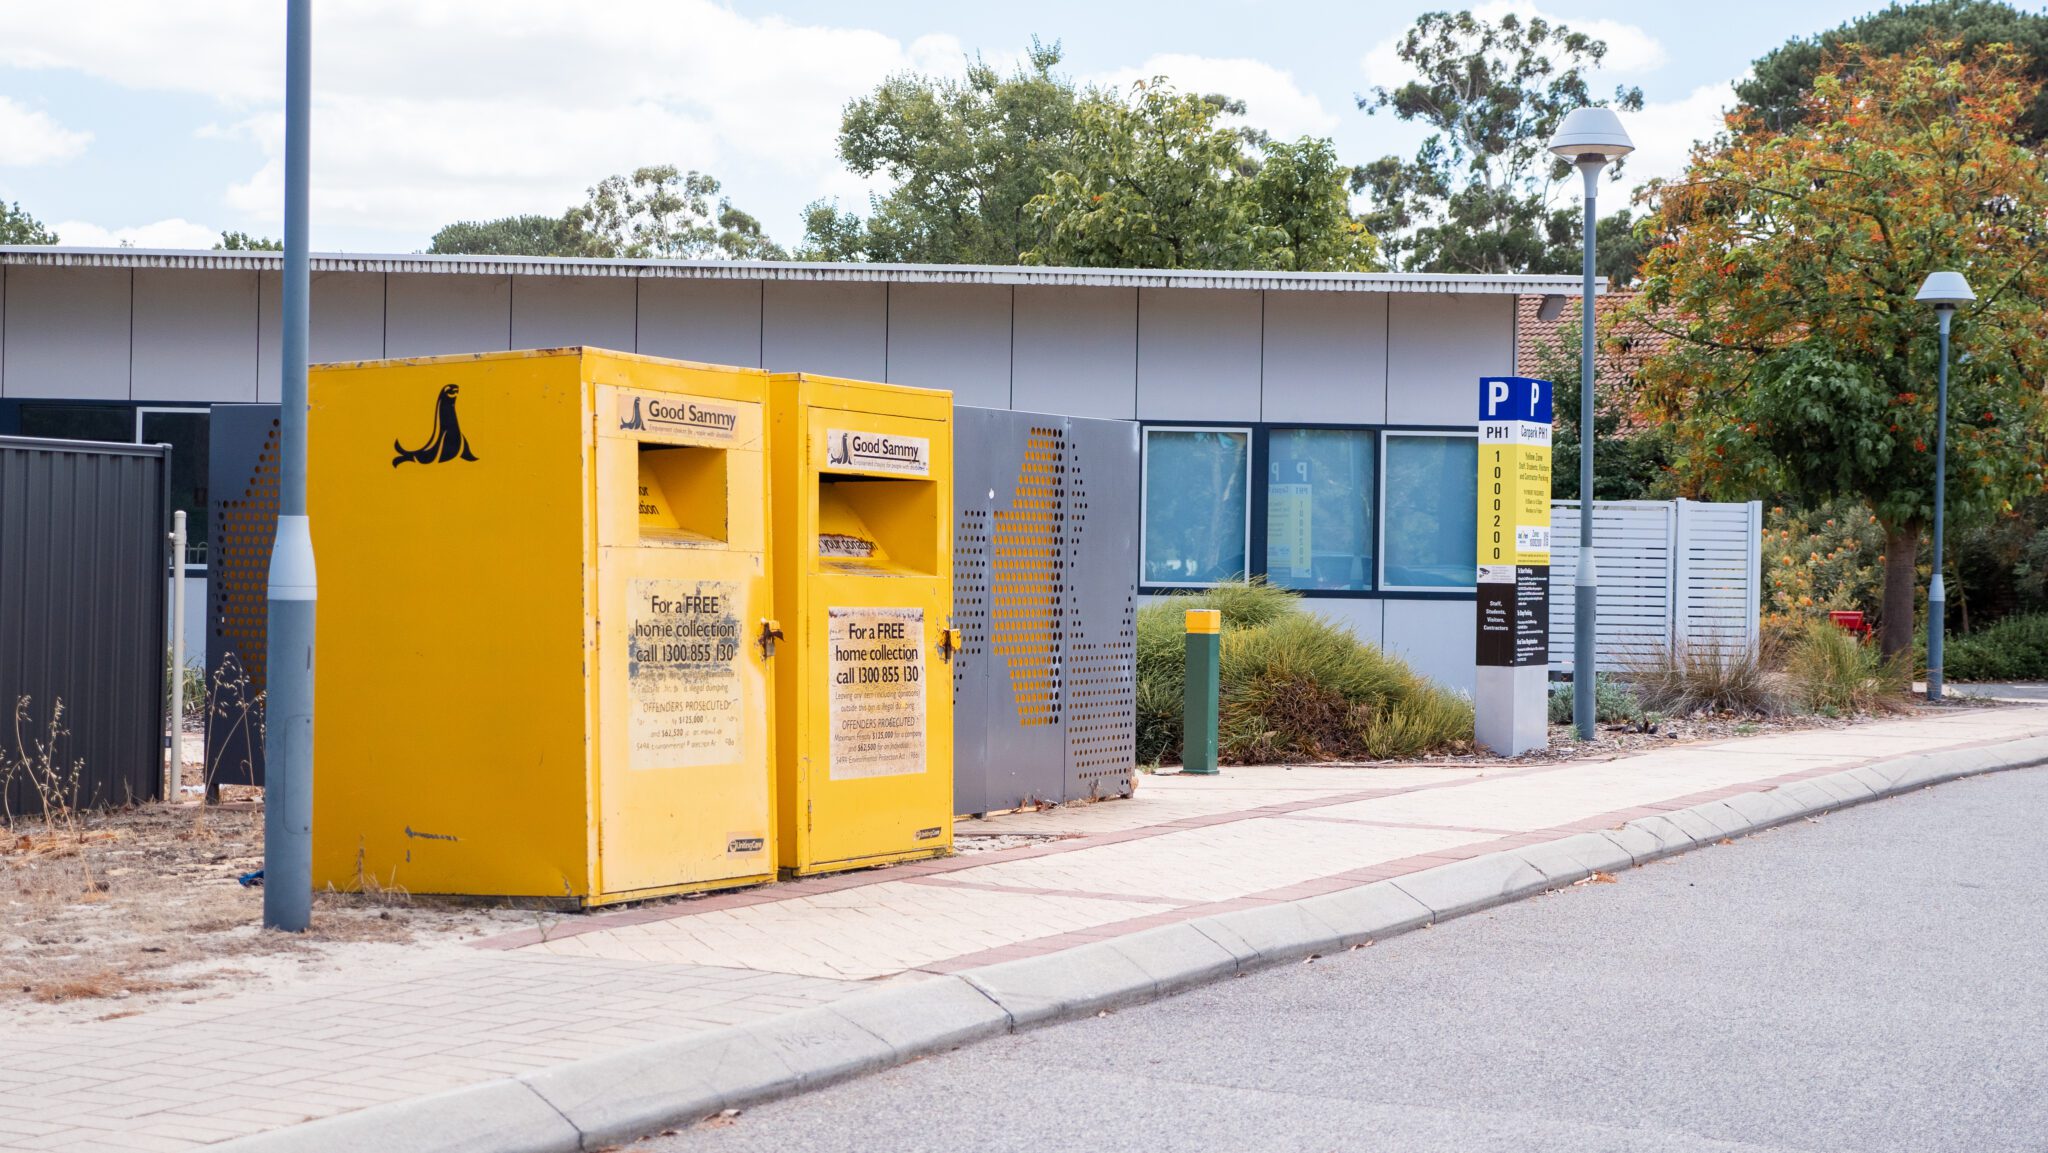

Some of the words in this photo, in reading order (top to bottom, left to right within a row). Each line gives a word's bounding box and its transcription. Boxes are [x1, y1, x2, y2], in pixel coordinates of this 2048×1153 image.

[1488, 381, 1509, 416] P
[1530, 382, 1540, 417] P
[648, 400, 685, 420] Good
[688, 404, 736, 431] Sammy
[1486, 426, 1509, 439] PH1
[1520, 424, 1538, 440] Carpark
[1538, 426, 1548, 440] PH1
[852, 435, 880, 454] Good
[882, 438, 919, 461] Sammy
[821, 539, 841, 552] your
[651, 595, 672, 613] For
[675, 601, 682, 613] a
[685, 596, 719, 613] FREE
[635, 619, 673, 637] home
[676, 620, 735, 637] collection
[849, 623, 867, 639] For
[868, 627, 875, 639] a
[877, 623, 905, 639] FREE
[636, 645, 657, 662] call
[663, 644, 687, 662] 1300
[690, 644, 710, 661] 855
[716, 644, 734, 661] 130
[835, 644, 867, 661] home
[869, 644, 918, 661] collection
[836, 667, 855, 684] call
[858, 667, 880, 684] 1300
[882, 666, 900, 683] 855
[903, 665, 919, 682] 130
[643, 701, 684, 713] OFFENDERS
[685, 700, 729, 712] PROSECUTED
[842, 718, 877, 731] OFFENDERS
[877, 716, 916, 729] PROSECUTED
